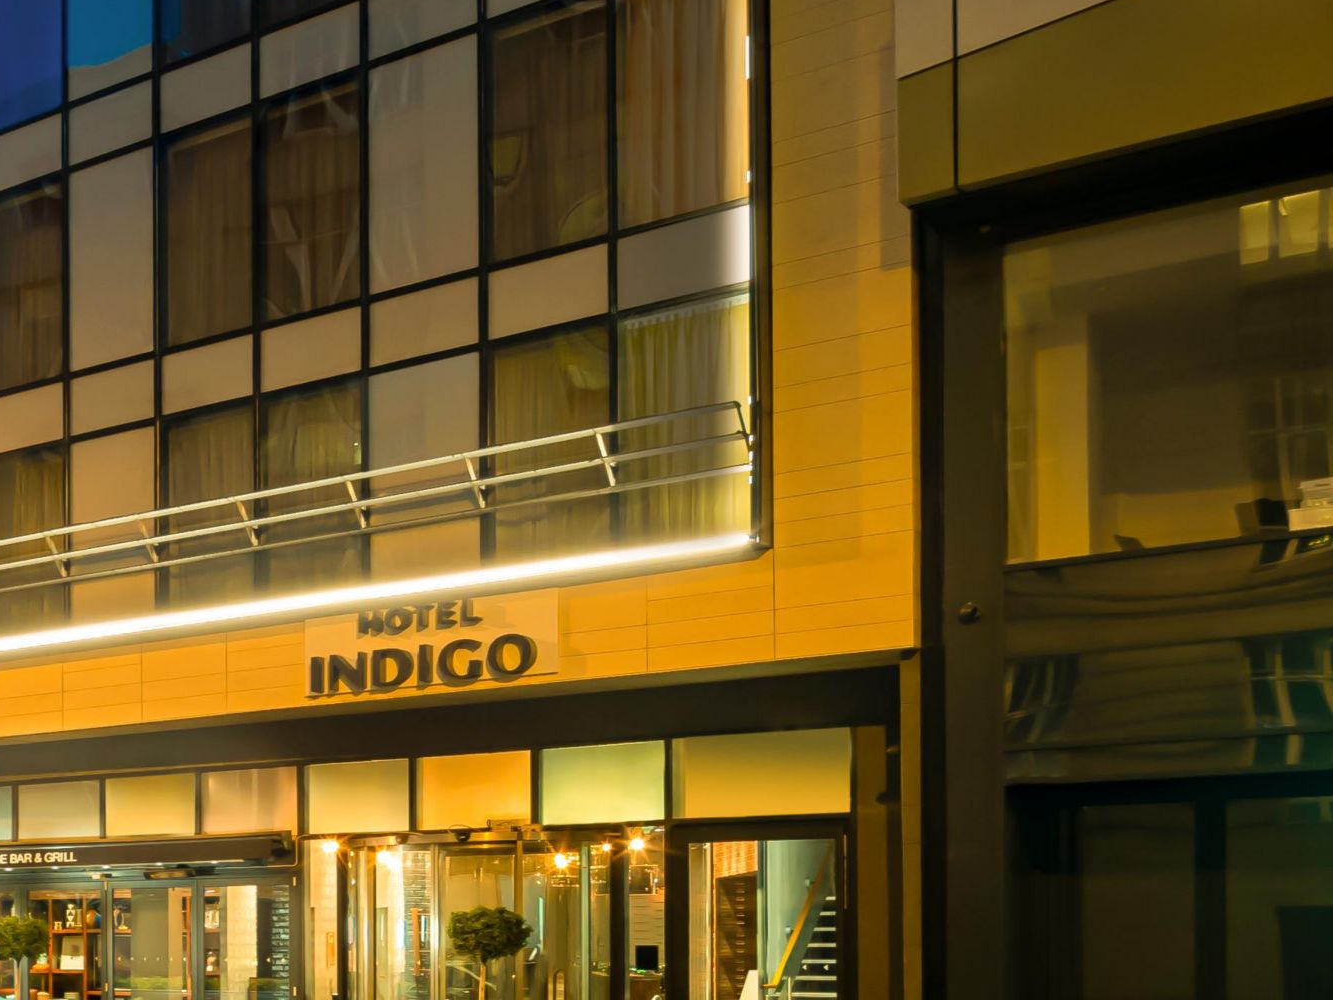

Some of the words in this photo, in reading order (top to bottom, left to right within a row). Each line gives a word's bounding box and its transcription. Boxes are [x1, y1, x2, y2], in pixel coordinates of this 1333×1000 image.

[357, 599, 483, 637] HOTEL
[310, 633, 539, 695] INDIGO
[9, 853, 33, 864] BAR
[34, 853, 42, 863] &
[44, 852, 77, 863] GRILL
